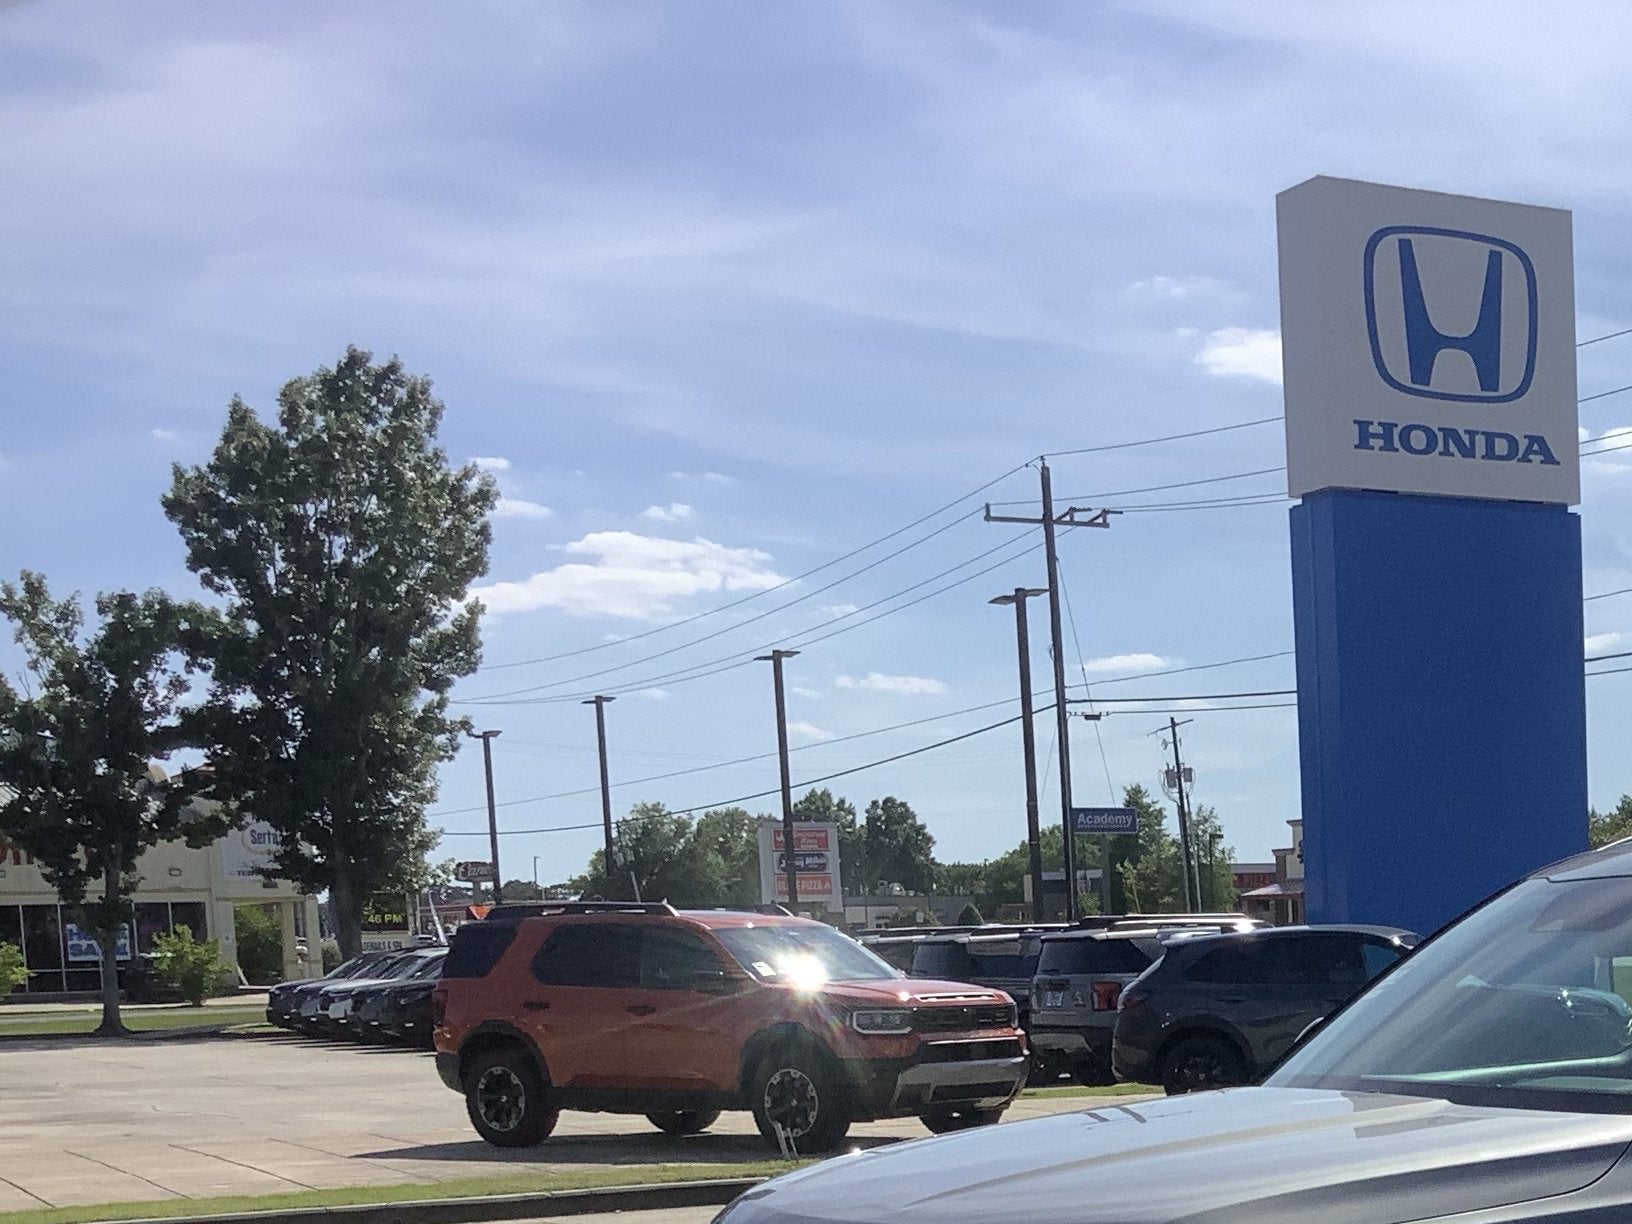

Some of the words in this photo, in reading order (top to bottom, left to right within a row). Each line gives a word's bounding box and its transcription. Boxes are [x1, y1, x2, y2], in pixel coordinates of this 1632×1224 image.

[1353, 419, 1561, 465] HONDA
[1078, 812, 1133, 828] Academy
[384, 913, 403, 924] PM
